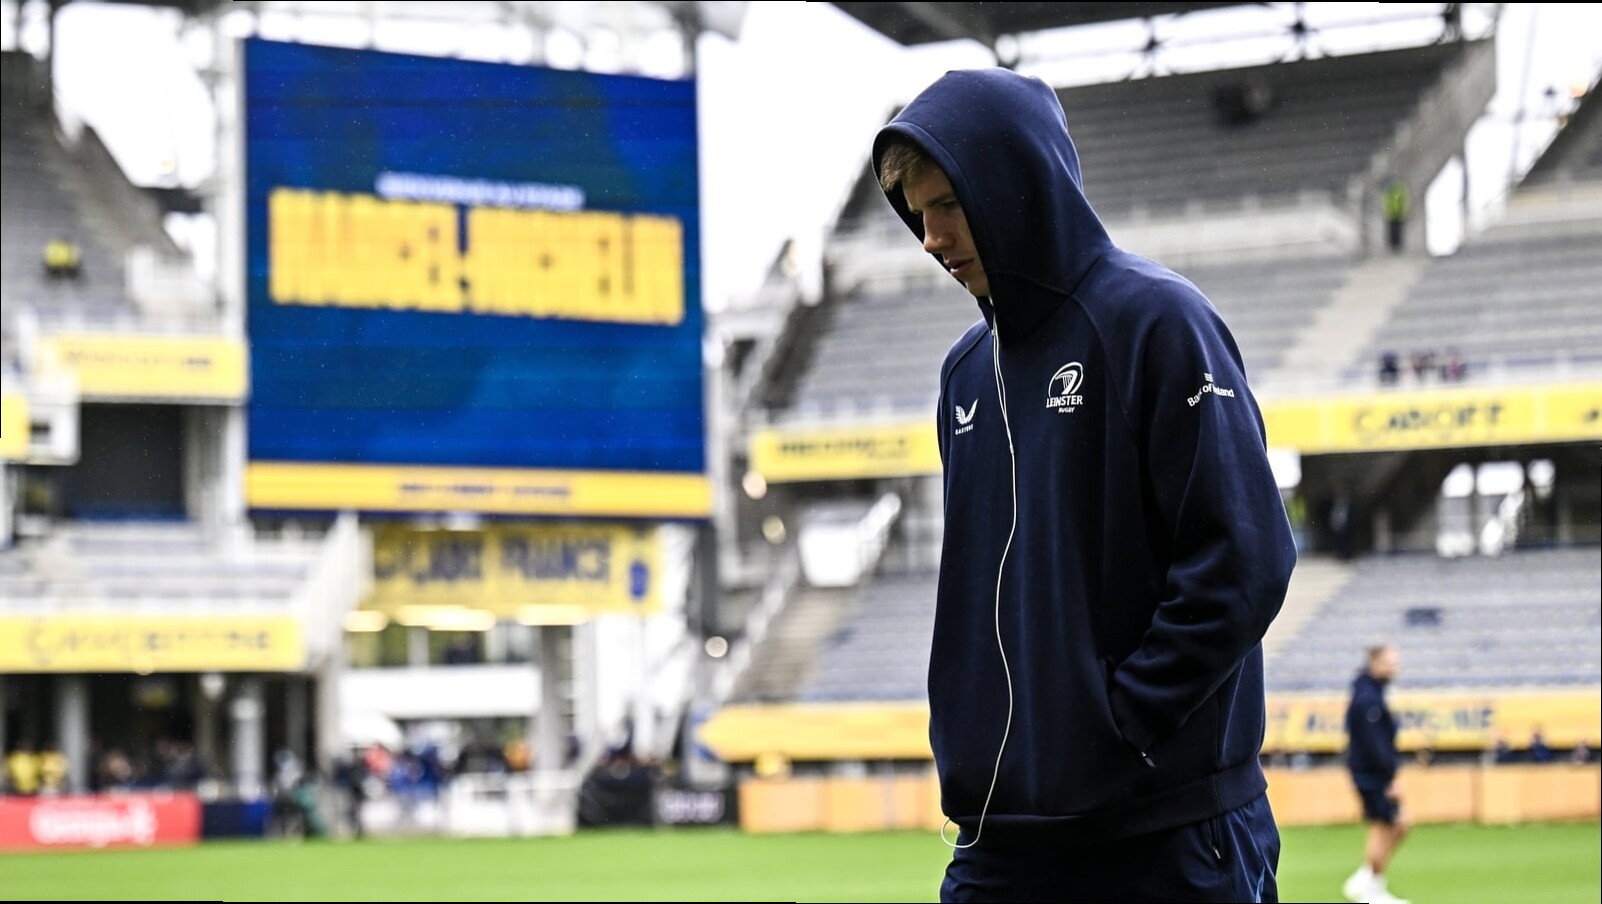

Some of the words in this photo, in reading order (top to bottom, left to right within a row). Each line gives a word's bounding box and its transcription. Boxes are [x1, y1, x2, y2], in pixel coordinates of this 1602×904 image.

[1202, 383, 1213, 393] of
[1212, 384, 1235, 398] Iland
[1046, 395, 1083, 408] LEINSTER
